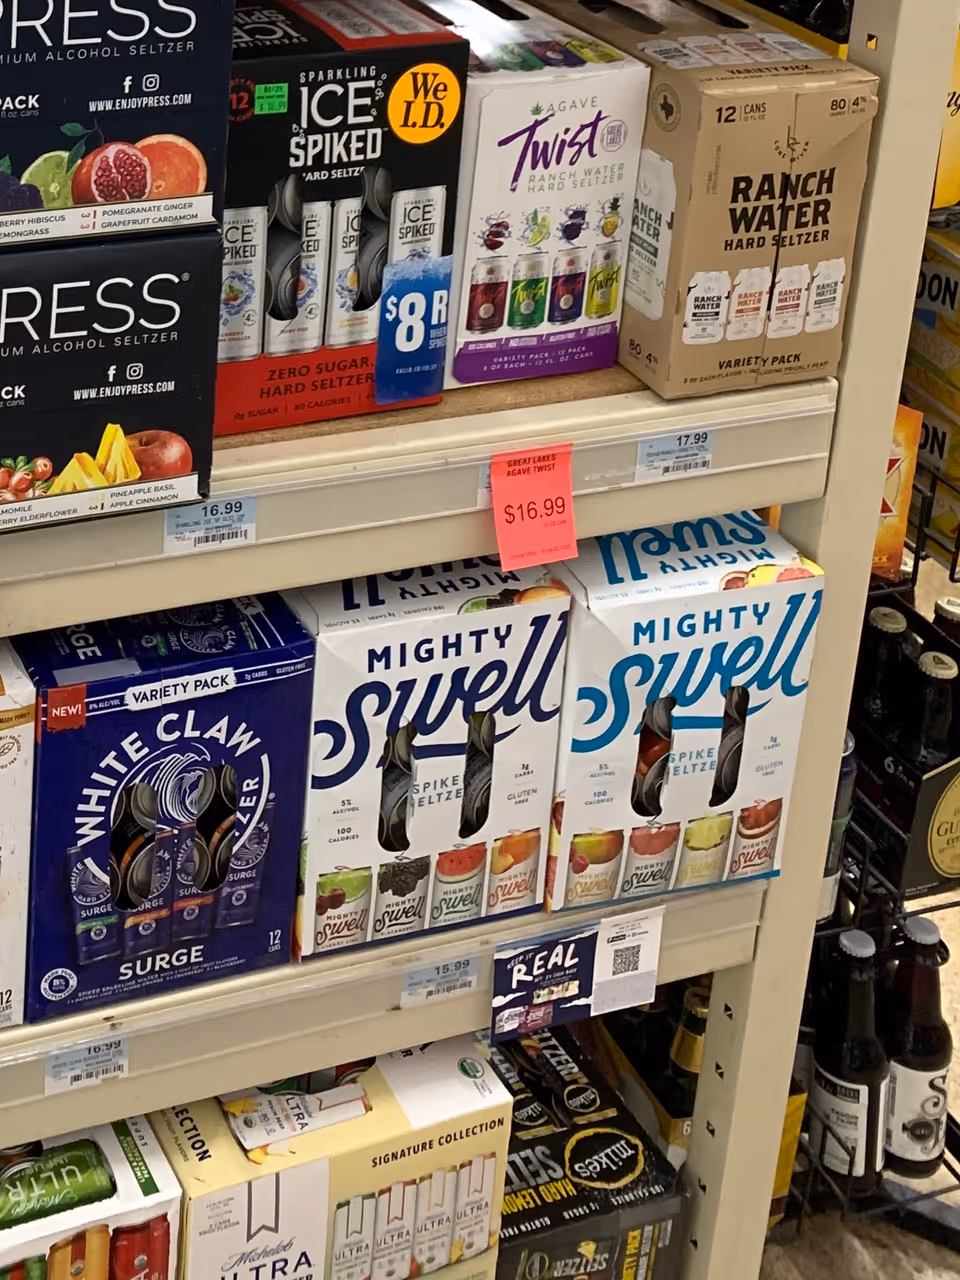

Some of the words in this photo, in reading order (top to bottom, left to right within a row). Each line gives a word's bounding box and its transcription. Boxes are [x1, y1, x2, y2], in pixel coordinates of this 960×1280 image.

[46, 46, 120, 60] ALCOHOL
[129, 41, 194, 55] SELTZER
[89, 94, 192, 112] WWW.ENJOYPRESS.COM
[302, 80, 374, 130] ICE
[546, 97, 598, 114] AGAVE
[289, 128, 383, 168] SPIKED
[498, 110, 609, 192] Twist
[529, 170, 577, 183] RANCH
[584, 163, 625, 177] WATER
[731, 167, 836, 204] RANCH
[28, 215, 66, 225] HIBISCUS
[102, 205, 161, 217] POMEGRANATE
[163, 202, 193, 212] GINGER
[728, 199, 830, 234] WATER
[724, 236, 766, 251] HARD
[772, 230, 829, 248] SELTZER
[385, 291, 427, 353] $8
[268, 365, 310, 381] ZERO
[719, 354, 767, 370] VARIETY
[771, 352, 801, 366] PACK
[677, 432, 708, 447] 17.99
[202, 501, 243, 517] 16.99
[505, 497, 565, 524] $16.99
[367, 624, 512, 673] MIGHTY
[73, 730, 150, 846] WHITE
[156, 709, 261, 758] CLAW
[118, 944, 204, 982] SURGE
[512, 943, 579, 989] REAL
[372, 1140, 434, 1168] SIGNATURE
[438, 1116, 505, 1147] COLLECTION
